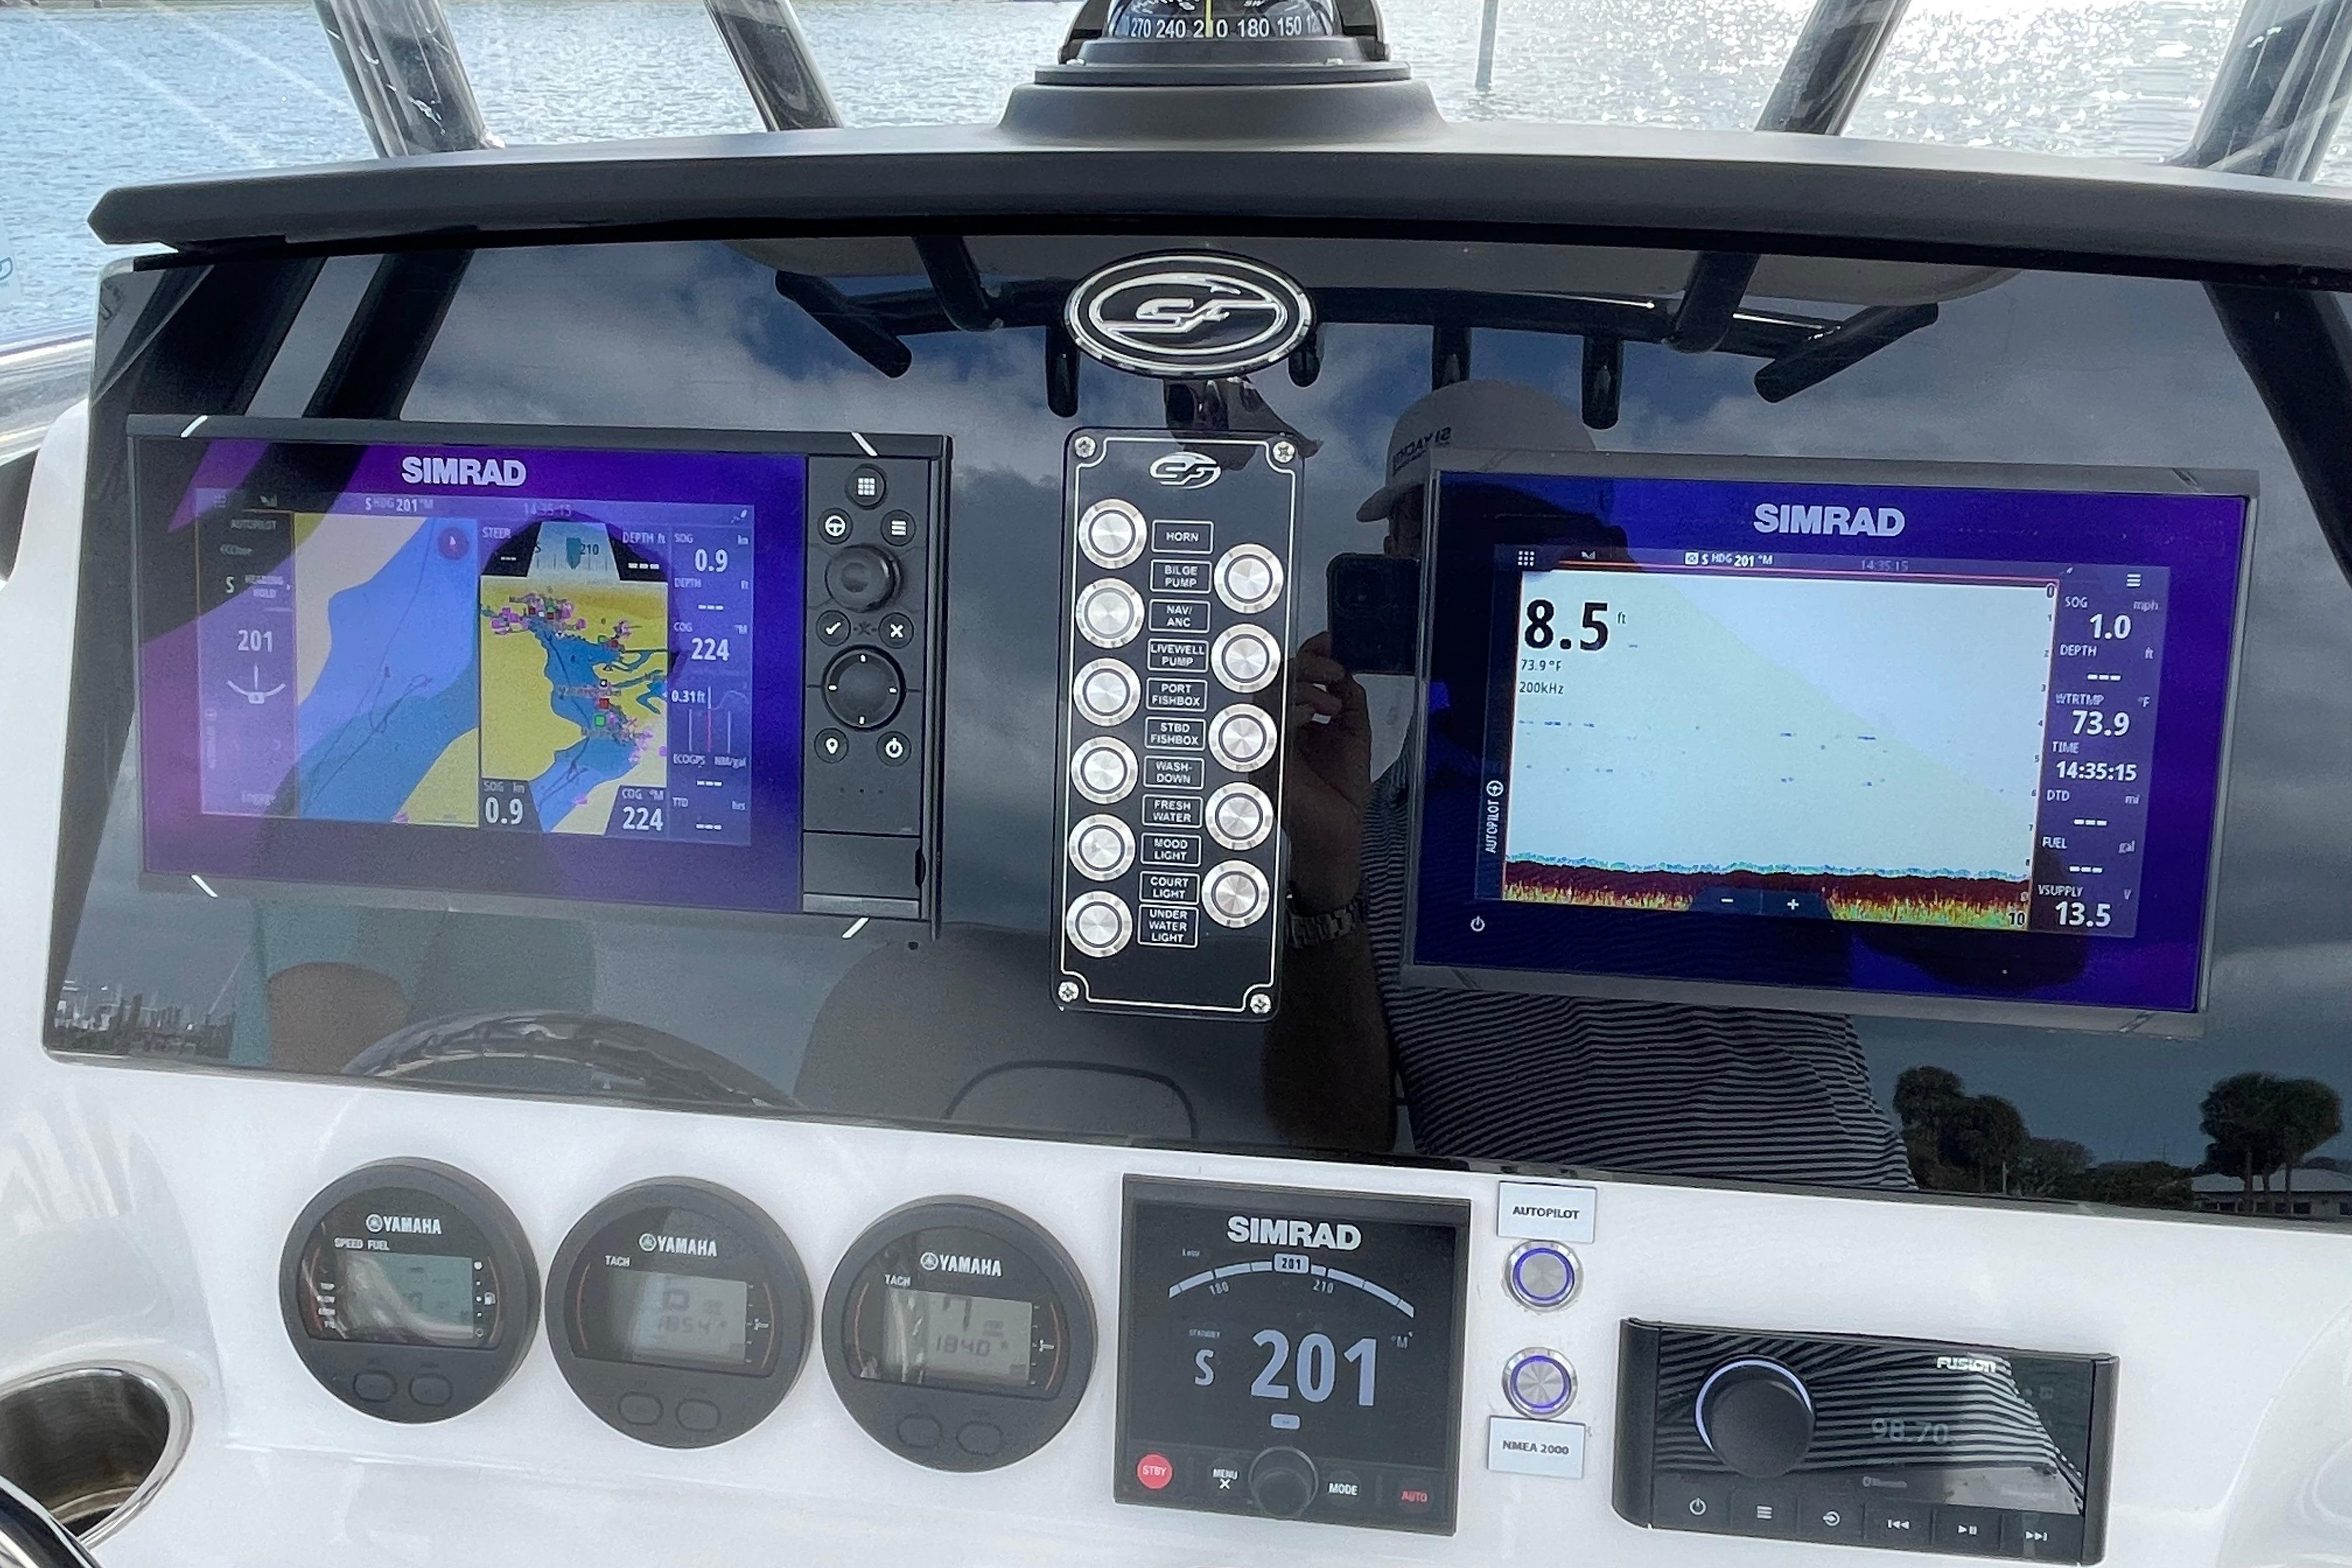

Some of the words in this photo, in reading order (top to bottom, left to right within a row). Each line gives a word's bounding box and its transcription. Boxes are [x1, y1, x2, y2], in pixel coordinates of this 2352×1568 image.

[1131, 18, 1152, 38] 270
[1156, 19, 1186, 38] 240
[1238, 18, 1270, 38] 180
[1278, 16, 1302, 36] 150
[401, 457, 526, 487] SIMRAD
[396, 499, 418, 512] 201
[1754, 503, 1906, 537] SIMRAD
[622, 531, 654, 543] DEPTH
[1166, 531, 1199, 542] HORN
[695, 548, 728, 572] 0.9
[1712, 552, 1732, 564] HDG
[1734, 555, 1755, 567] 201
[1164, 565, 1198, 576] BILGE
[1164, 577, 1197, 588] PUMP
[2065, 596, 2088, 608] SOG
[1167, 605, 1193, 616] NAV/
[1167, 617, 1191, 628] ANC
[1524, 598, 1609, 651] 8.5
[2089, 614, 2132, 639] 1.0
[238, 629, 274, 652] 201
[691, 638, 730, 661] 224
[1150, 644, 1205, 656] LIVEWELL
[2059, 644, 2097, 657] DEPTH
[1162, 656, 1194, 667] PUMP
[1161, 684, 1192, 694] PORT
[1519, 681, 1564, 695] 200kHz
[1152, 695, 1200, 706] FISHBOX
[1160, 722, 1190, 733] STBD
[2072, 709, 2130, 736] 73.9
[1150, 734, 1199, 746] FISHBOX
[2052, 741, 2079, 754] TIME
[1156, 761, 1193, 772] WASH-
[2056, 761, 2137, 781] 14:35:15
[1156, 773, 1191, 784] DOWN
[622, 789, 642, 800] COG
[2046, 789, 2070, 802] DTD
[485, 797, 524, 825] 0.9
[1154, 800, 1191, 811] FRESH
[622, 806, 664, 831] 224
[1153, 812, 1191, 823] WATER
[1485, 799, 1499, 854] AUTOPILOT
[1154, 838, 1188, 849] MOOD
[2042, 836, 2068, 849] FUEL
[1154, 850, 1187, 862] LIGHT
[1150, 876, 1189, 887] COURT
[1152, 888, 1185, 899] LIGHT
[2038, 884, 2084, 898] VSUPPLY
[1149, 909, 1188, 920] UNDER
[2008, 911, 2025, 926] 10
[2055, 901, 2111, 928] 13.5
[1149, 921, 1187, 932] WATER
[1152, 932, 1184, 943] LIGHT
[1512, 1205, 1580, 1221] AUTOPILOT
[382, 1215, 442, 1235] YAMAHA
[1227, 1215, 1362, 1251] SIMRAD
[334, 1237, 363, 1249] SPEED
[368, 1239, 390, 1251] FUEL
[657, 1236, 718, 1257] YAMAHA
[605, 1255, 630, 1267] TACH
[940, 1255, 1002, 1277] YAMAHA
[1282, 1258, 1301, 1271] 201
[884, 1274, 911, 1287] TACH
[1209, 1281, 1230, 1296] 180
[1312, 1280, 1334, 1294] 210
[1194, 1349, 1214, 1387] S
[1251, 1329, 1377, 1406] 201
[1936, 1356, 1996, 1373] FUSION
[1502, 1439, 1538, 1453] NMEA
[1541, 1441, 1570, 1455] 2000
[1142, 1465, 1167, 1476] STBY
[1212, 1468, 1238, 1480] MENU
[1328, 1482, 1358, 1496] MODE
[1401, 1490, 1428, 1503] AUTO
